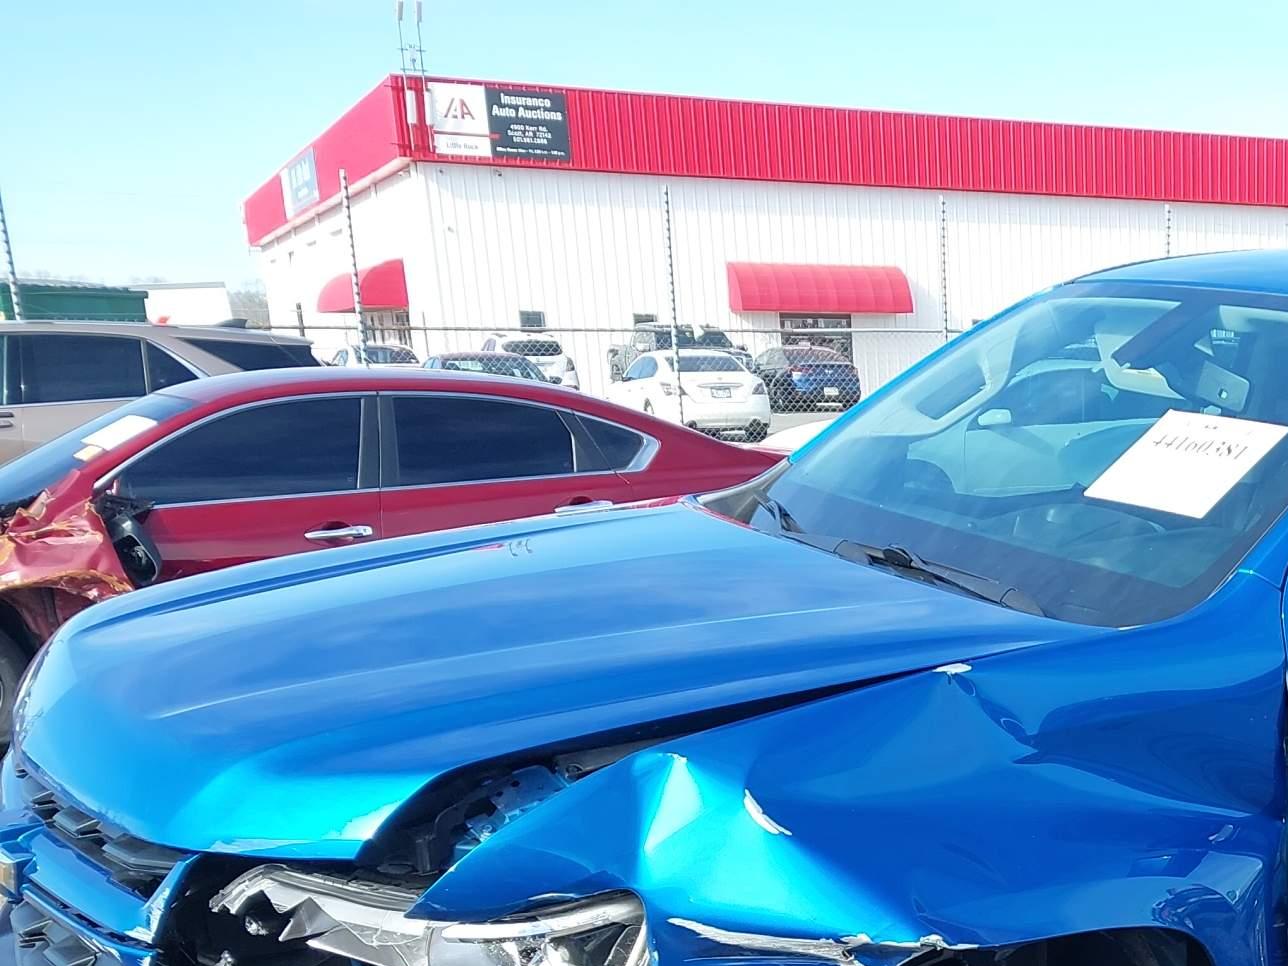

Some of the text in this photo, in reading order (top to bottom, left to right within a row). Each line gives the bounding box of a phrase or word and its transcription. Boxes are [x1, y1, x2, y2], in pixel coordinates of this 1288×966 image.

[500, 92, 551, 107] Insurance
[491, 104, 563, 120] Auto Auctions
